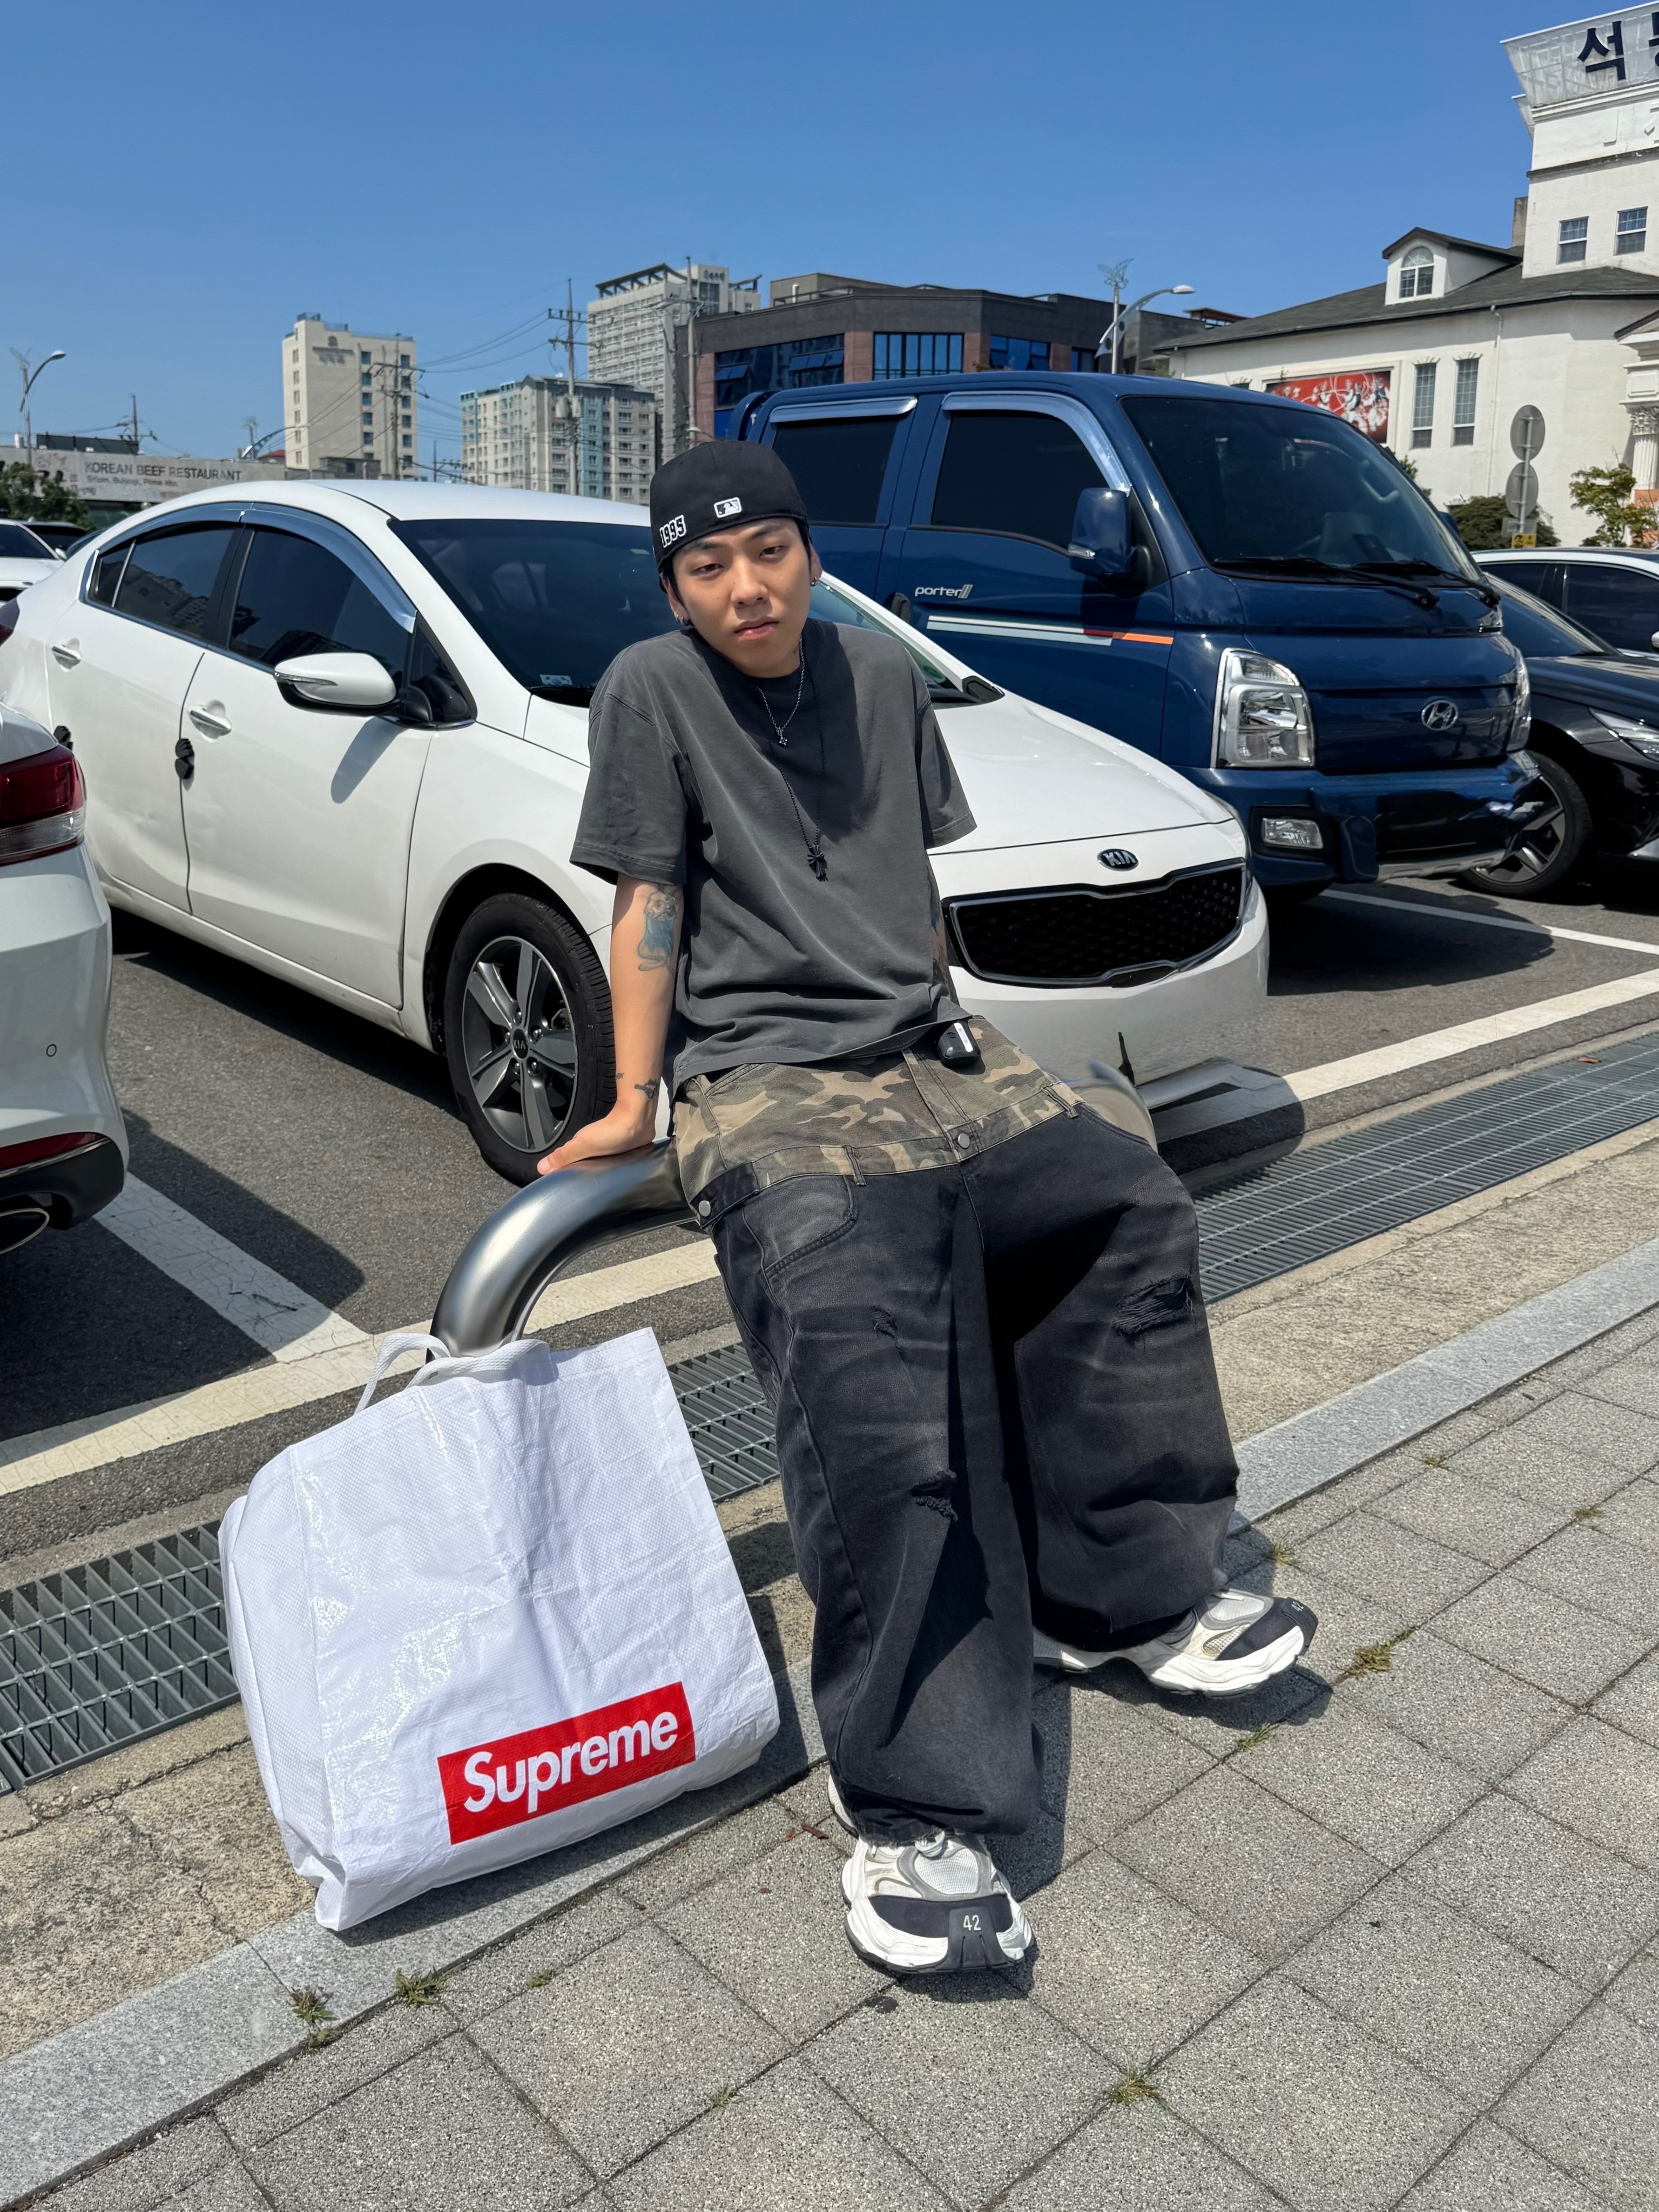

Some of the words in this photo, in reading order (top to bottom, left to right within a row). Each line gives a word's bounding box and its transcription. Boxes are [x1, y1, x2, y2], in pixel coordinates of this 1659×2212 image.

[85, 462, 132, 475] KOREAN
[137, 464, 166, 477] BEEF
[168, 466, 242, 481] RESTAURANT
[659, 515, 687, 548] 1995
[1103, 851, 1136, 866] KIA
[513, 1040, 526, 1049] KIA
[1291, 1601, 1304, 1611] 42
[463, 1711, 678, 1814] Supreme
[963, 1914, 981, 1931] 42
